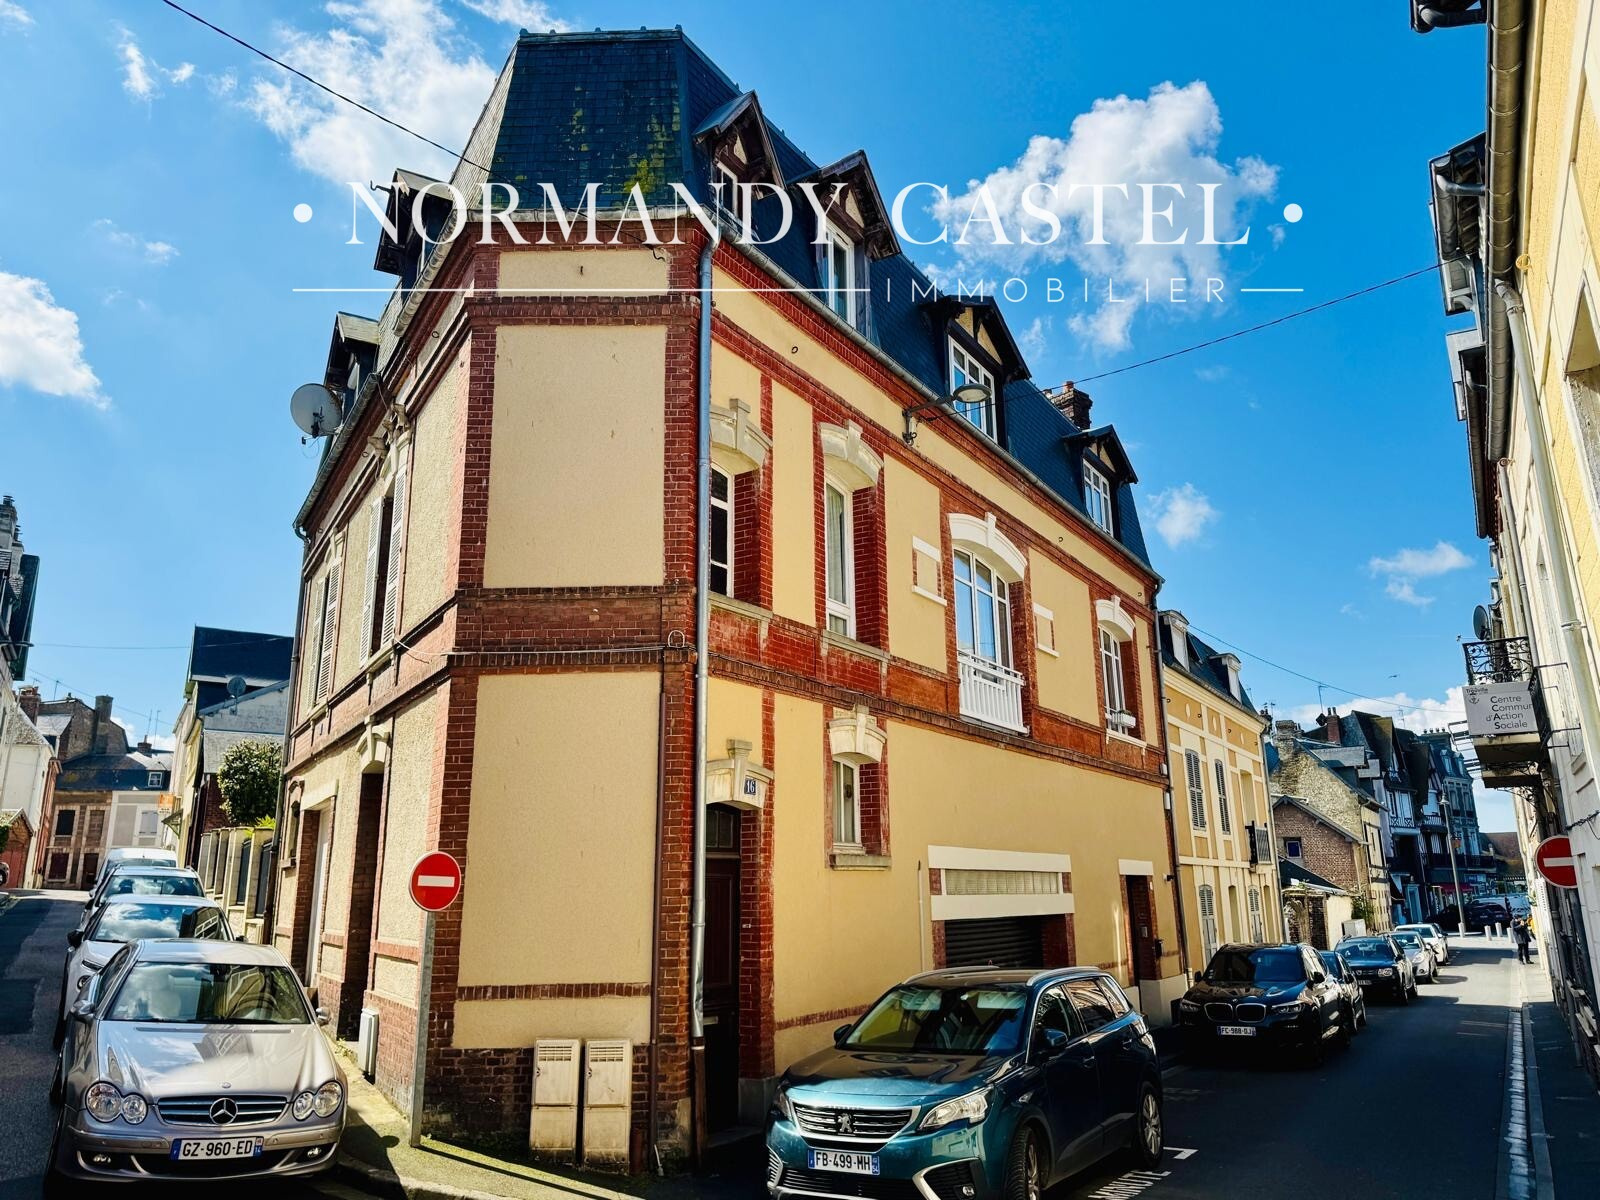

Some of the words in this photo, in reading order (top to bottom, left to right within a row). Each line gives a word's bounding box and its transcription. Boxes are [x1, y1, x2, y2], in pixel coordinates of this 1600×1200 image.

[1490, 695, 1521, 704] Centre
[1485, 712, 1523, 722] d'Action
[1494, 720, 1527, 730] Sociale
[746, 780, 755, 793] 16
[182, 1140, 253, 1157] GZ-960-ED
[815, 1152, 871, 1171] FB-499-MH
